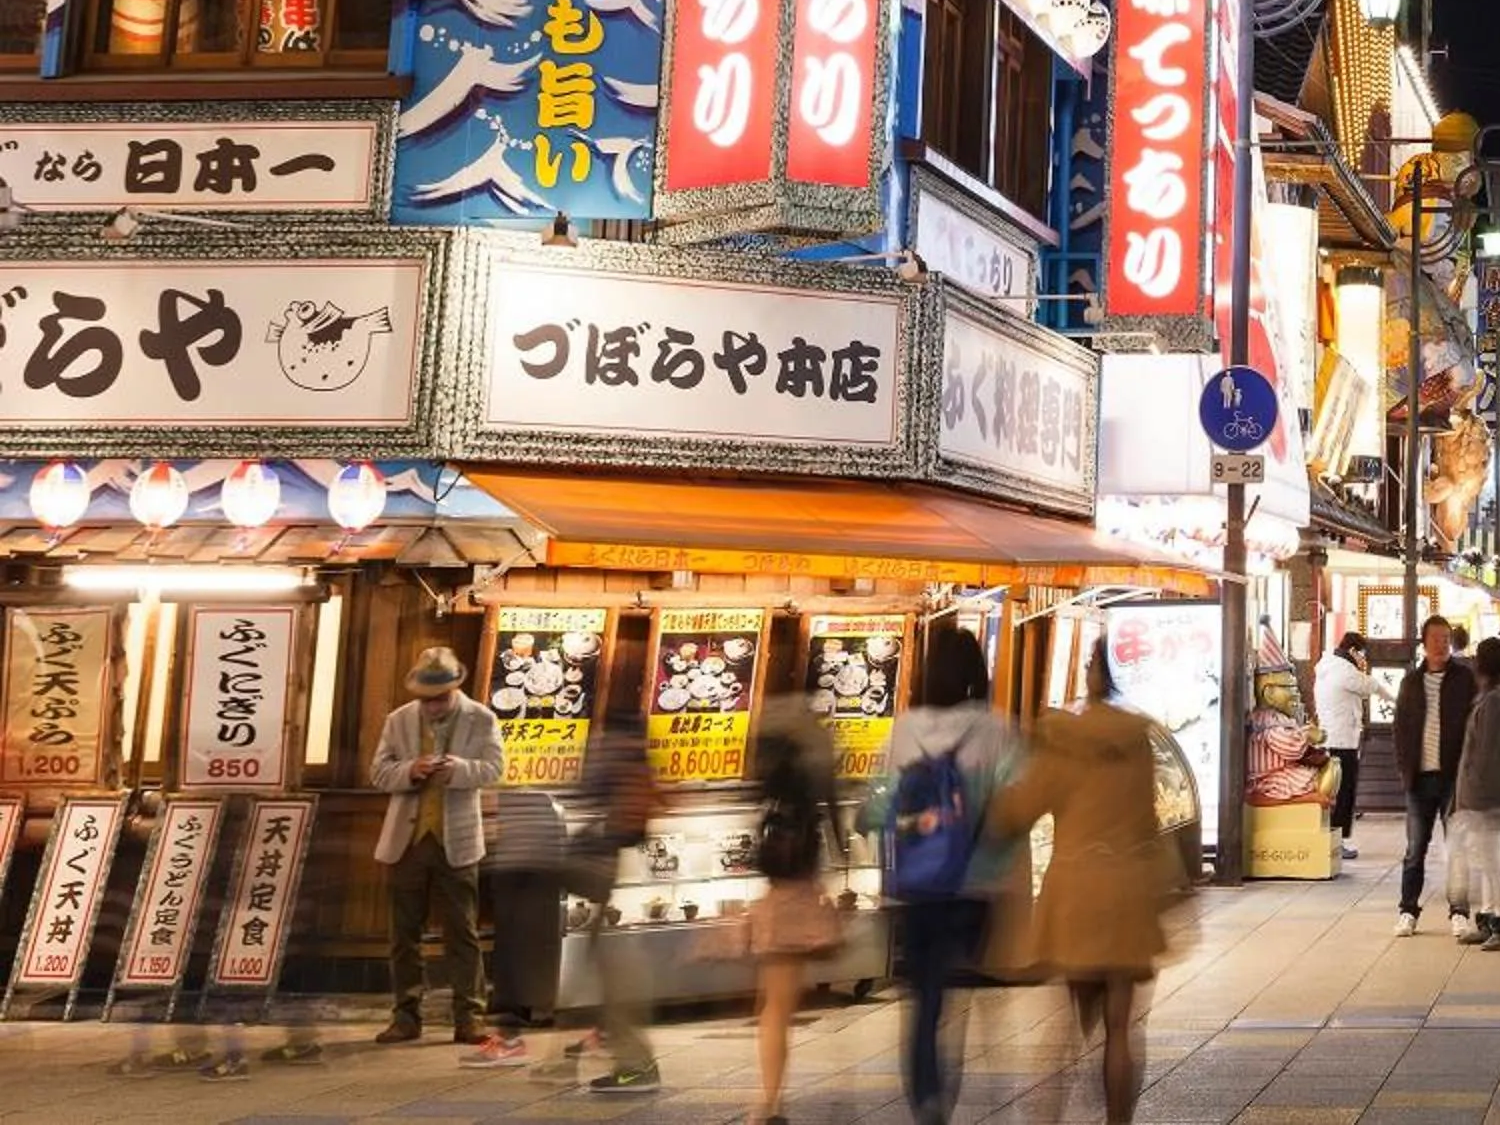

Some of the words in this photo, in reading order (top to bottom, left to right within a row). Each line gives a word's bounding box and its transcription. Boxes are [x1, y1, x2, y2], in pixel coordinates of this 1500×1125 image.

[0, 286, 243, 403] らや
[512, 318, 882, 403] づぼらや本店
[1213, 461, 1262, 479] 9-22
[28, 622, 83, 746] ふぐ天ぷら
[216, 619, 268, 748] ふぐにぎり
[207, 758, 260, 778] 850
[46, 814, 99, 945] ふぐ天丼
[150, 816, 203, 946] ふぐうどん定食
[241, 815, 293, 947] 天丼定食
